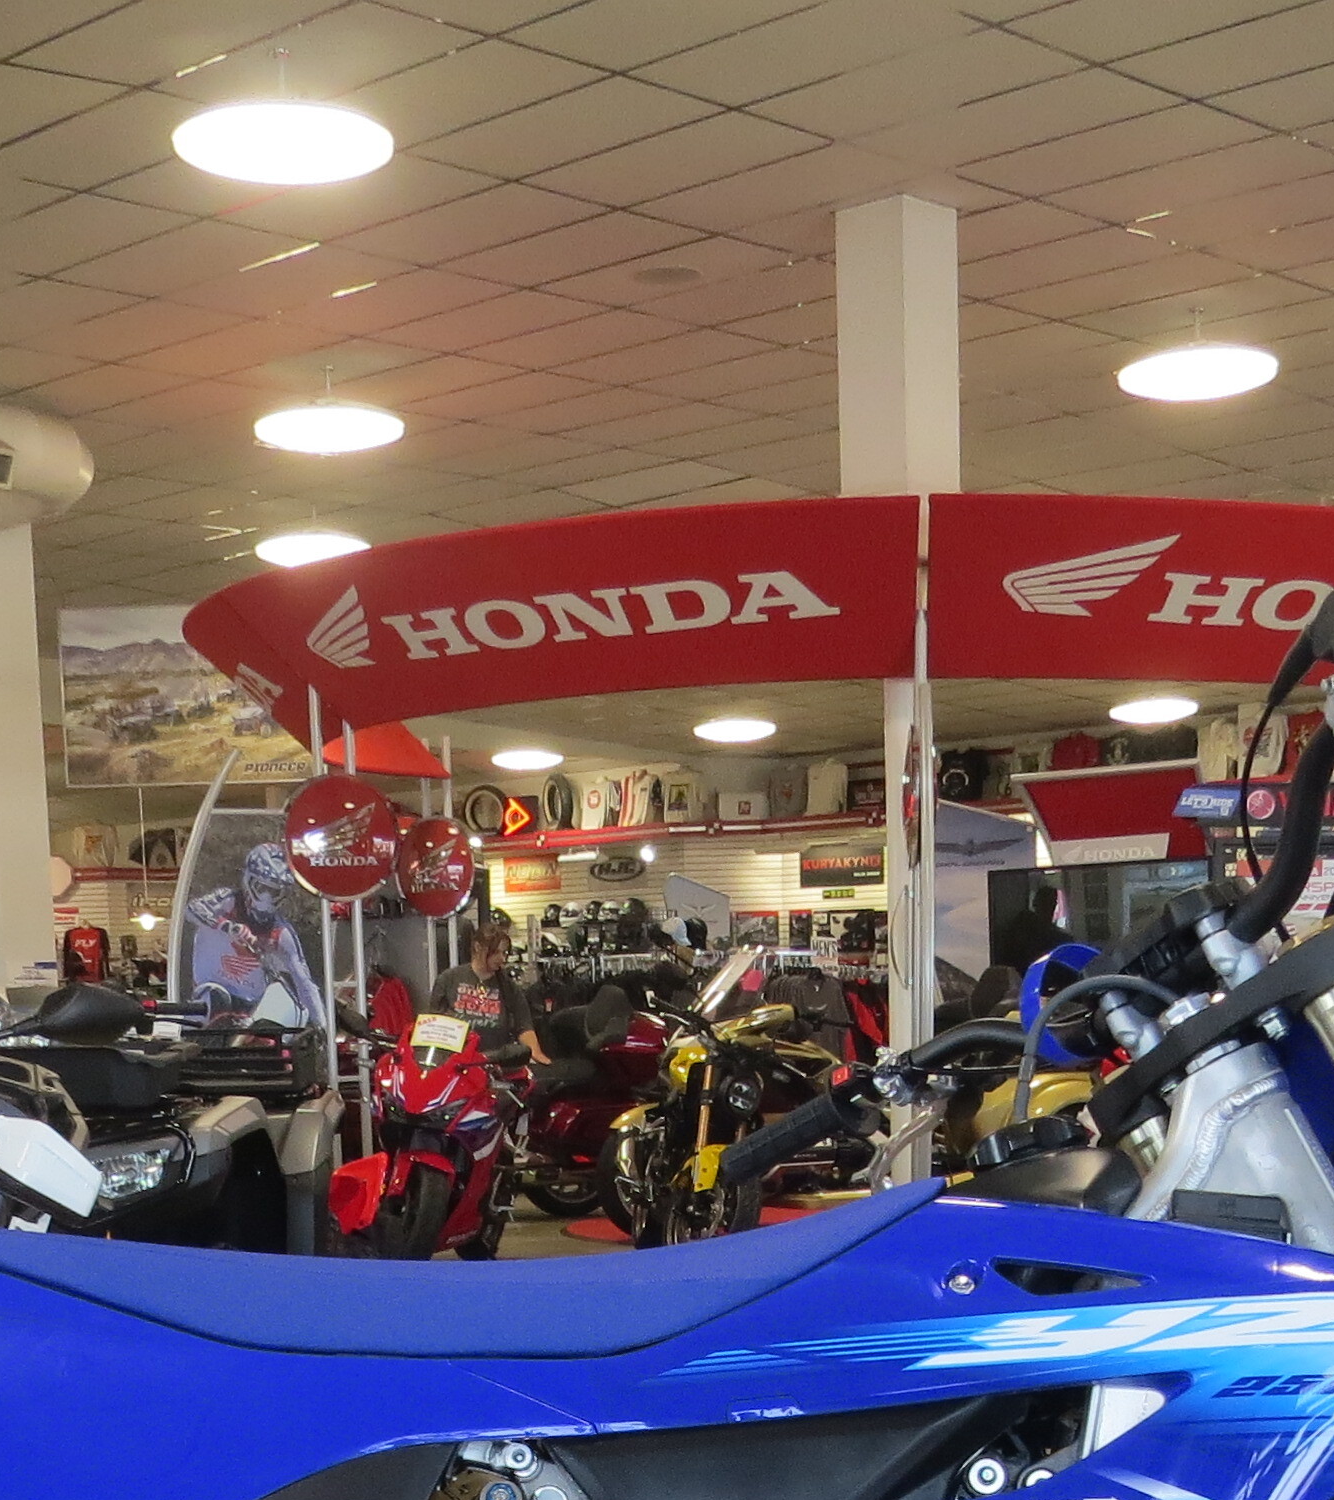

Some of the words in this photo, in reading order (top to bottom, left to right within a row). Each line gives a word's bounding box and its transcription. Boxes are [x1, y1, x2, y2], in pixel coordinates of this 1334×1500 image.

[382, 571, 841, 660] HONDA
[1084, 846, 1155, 862] HONDA
[309, 855, 380, 868] HONDA
[74, 938, 97, 949] FLY
